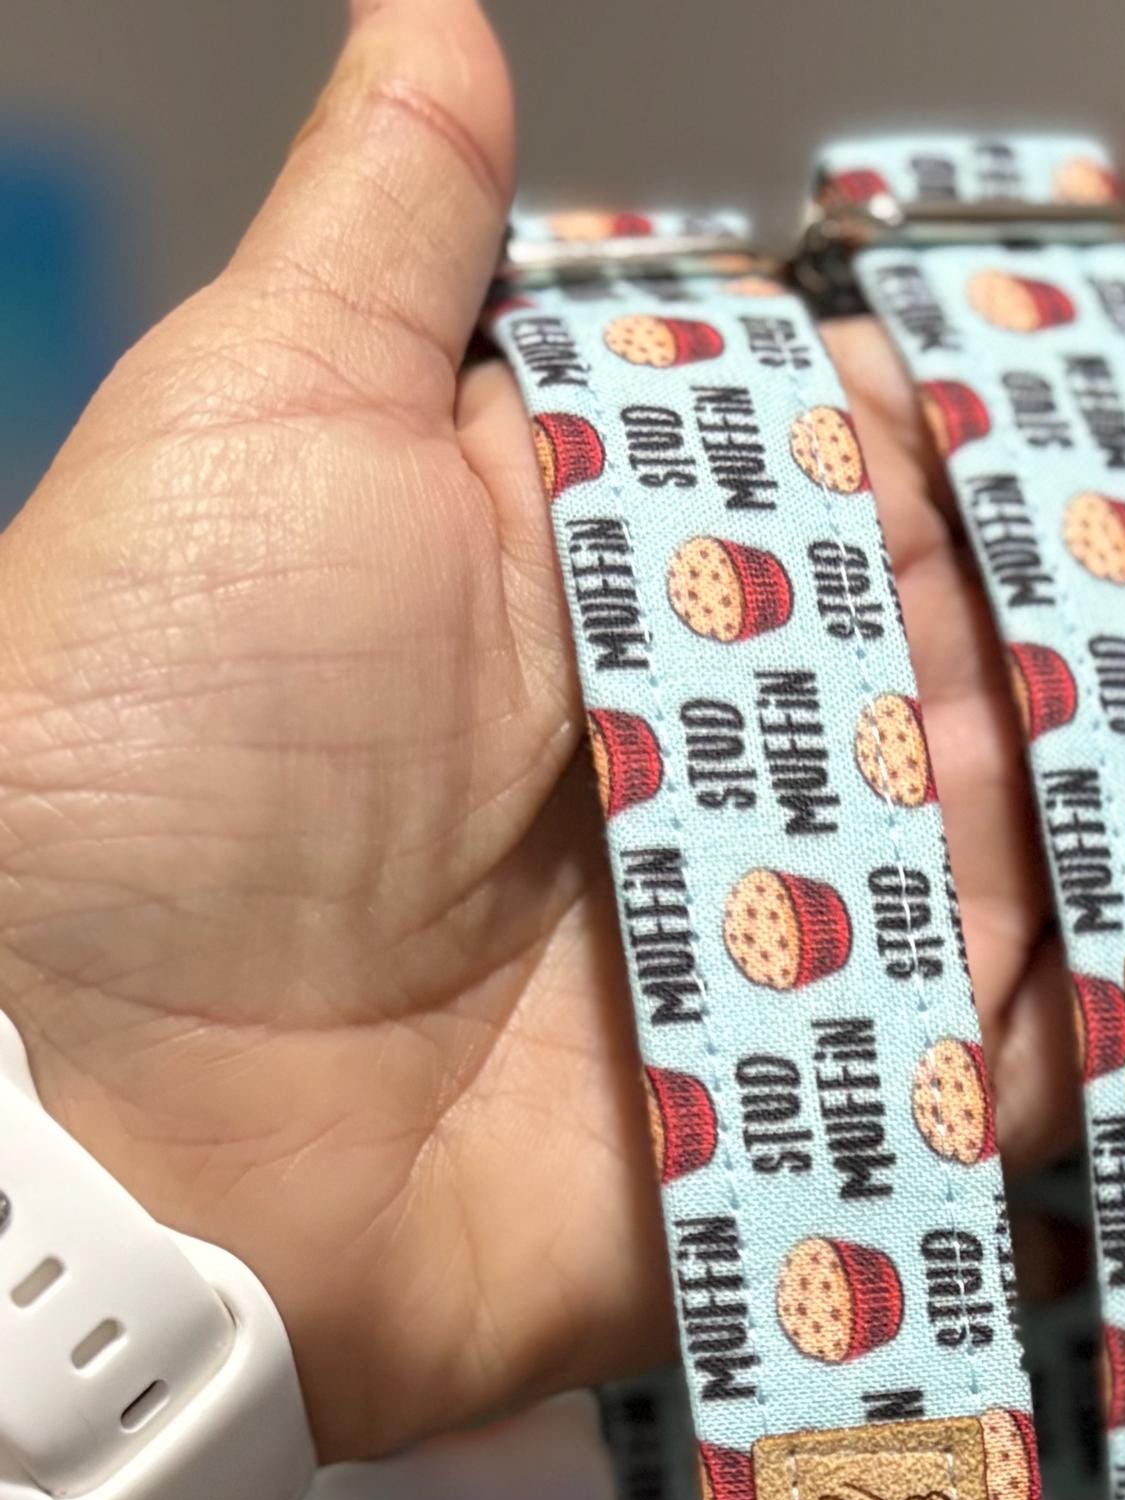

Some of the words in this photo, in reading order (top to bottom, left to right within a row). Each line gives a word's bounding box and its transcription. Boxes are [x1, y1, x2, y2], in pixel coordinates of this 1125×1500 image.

[620, 405, 698, 489] STUD
[807, 541, 885, 640] STUD
[680, 699, 757, 810] STUD
[868, 865, 945, 981] STUD
[735, 1055, 813, 1174] STUD
[921, 1229, 995, 1348] STUD
